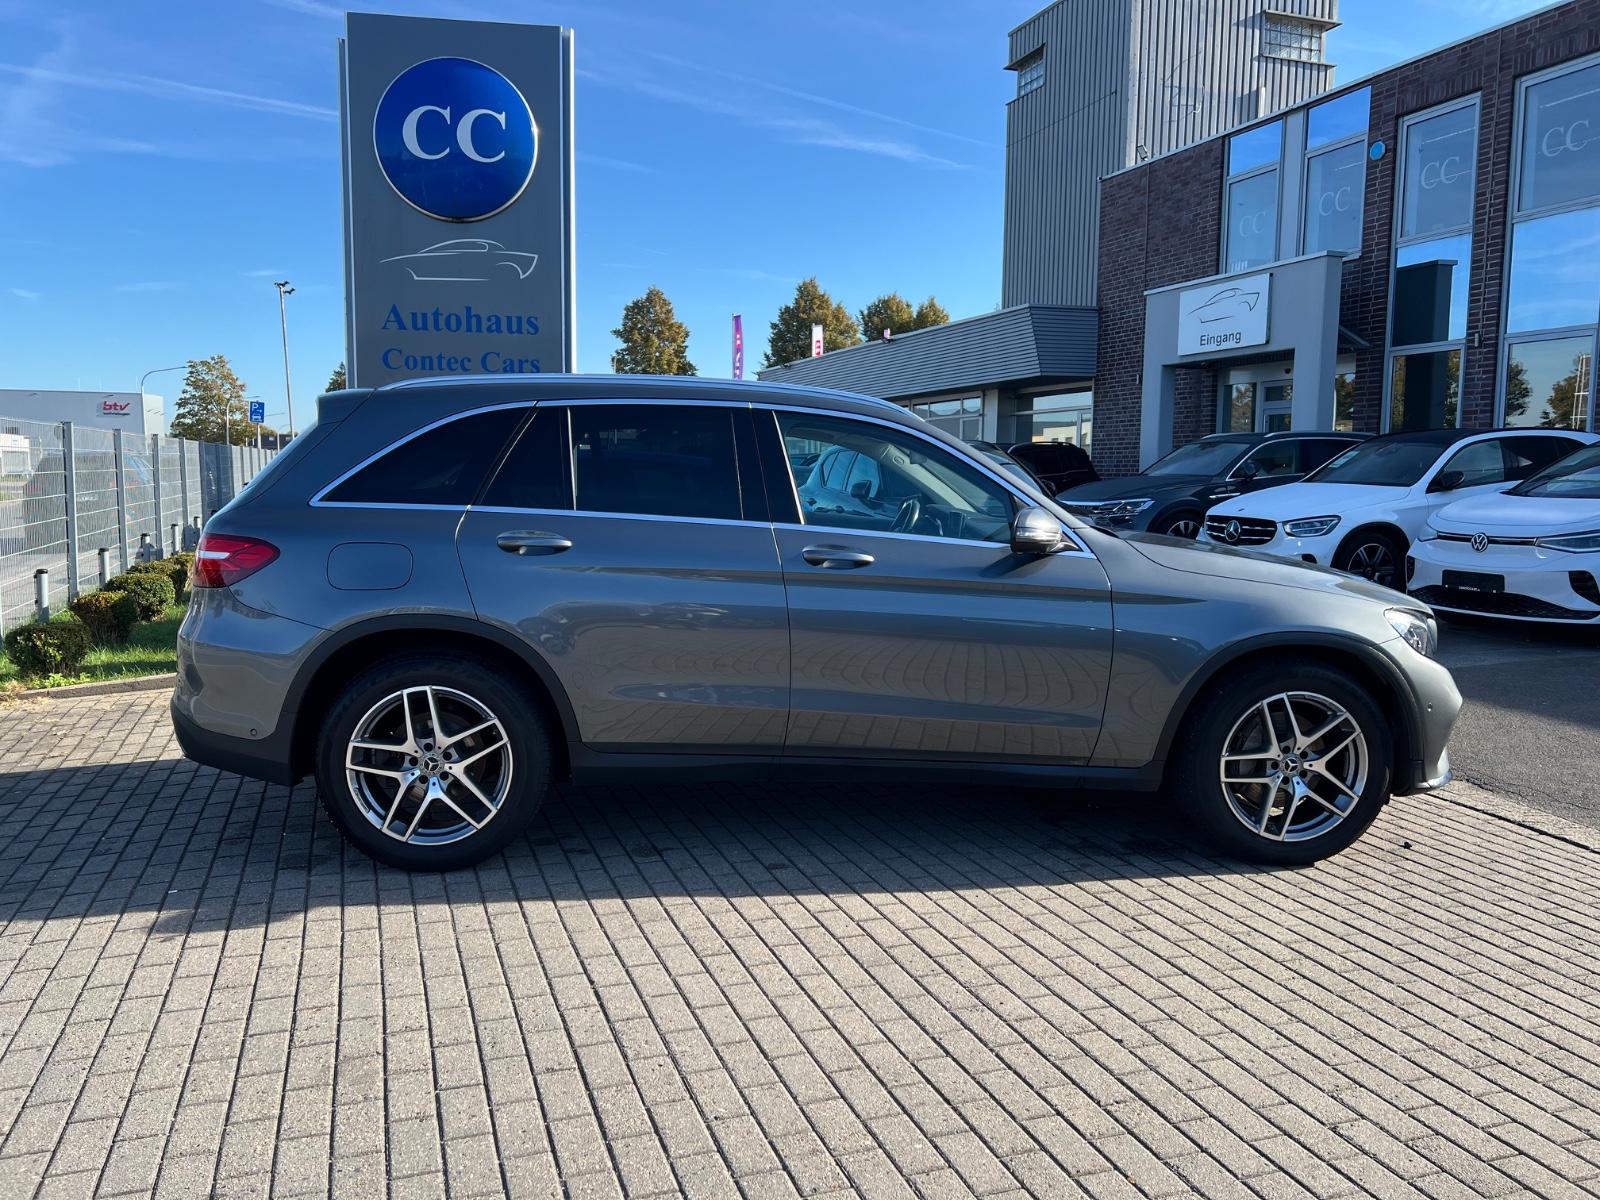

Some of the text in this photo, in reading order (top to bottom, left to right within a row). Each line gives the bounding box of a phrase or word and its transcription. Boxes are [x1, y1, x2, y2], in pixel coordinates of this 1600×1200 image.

[402, 105, 506, 163] CC
[381, 303, 540, 336] Autohaus
[1199, 331, 1242, 346] Eingang
[382, 348, 541, 374] Contec Cars
[103, 400, 130, 411] btv
